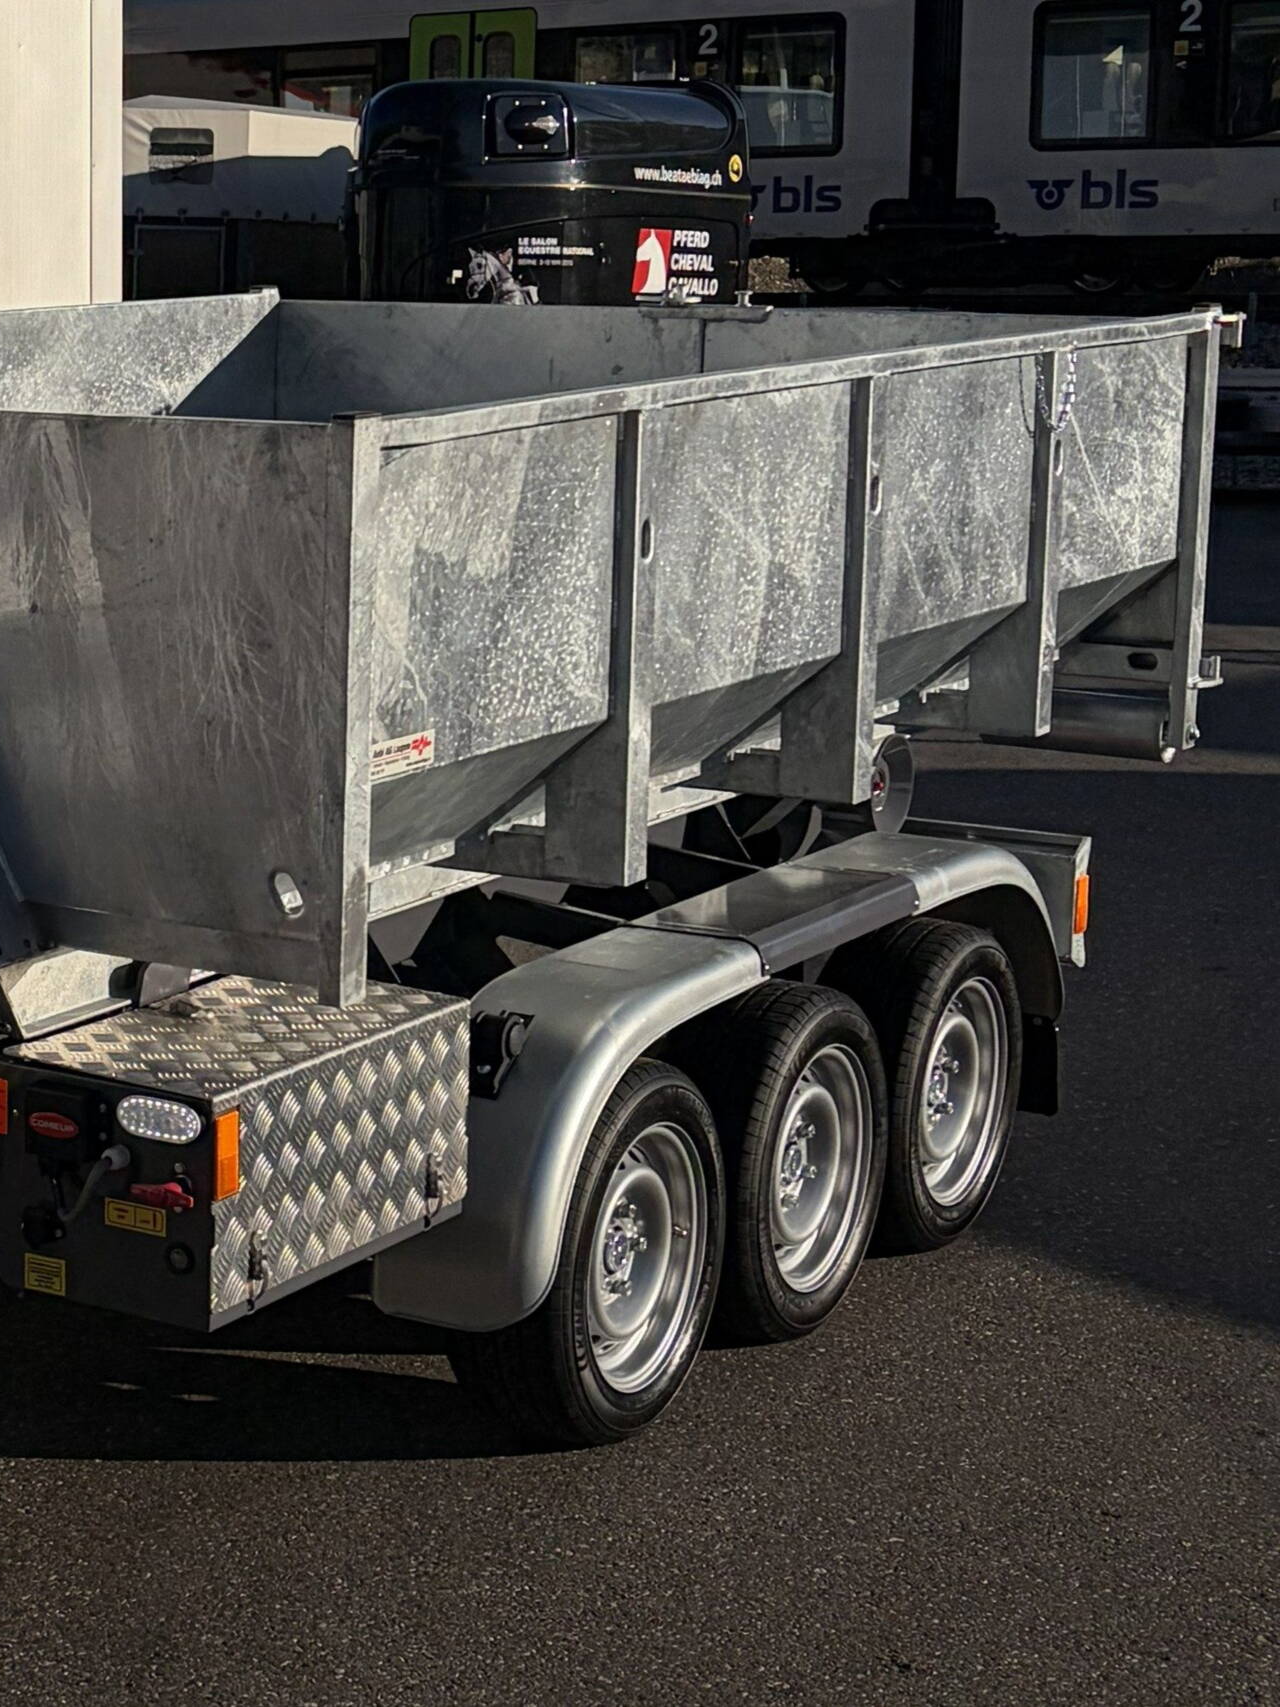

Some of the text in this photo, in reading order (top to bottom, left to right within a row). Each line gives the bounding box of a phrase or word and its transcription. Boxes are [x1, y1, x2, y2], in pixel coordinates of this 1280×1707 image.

[1179, 0, 1203, 32] 2
[698, 23, 718, 55] 2
[633, 164, 722, 189] www.beataebiag.ch
[1080, 169, 1159, 210] bls
[772, 175, 842, 214] bls
[517, 237, 529, 246] LE
[673, 229, 710, 248] PFERD
[670, 252, 715, 272] CHEVAL
